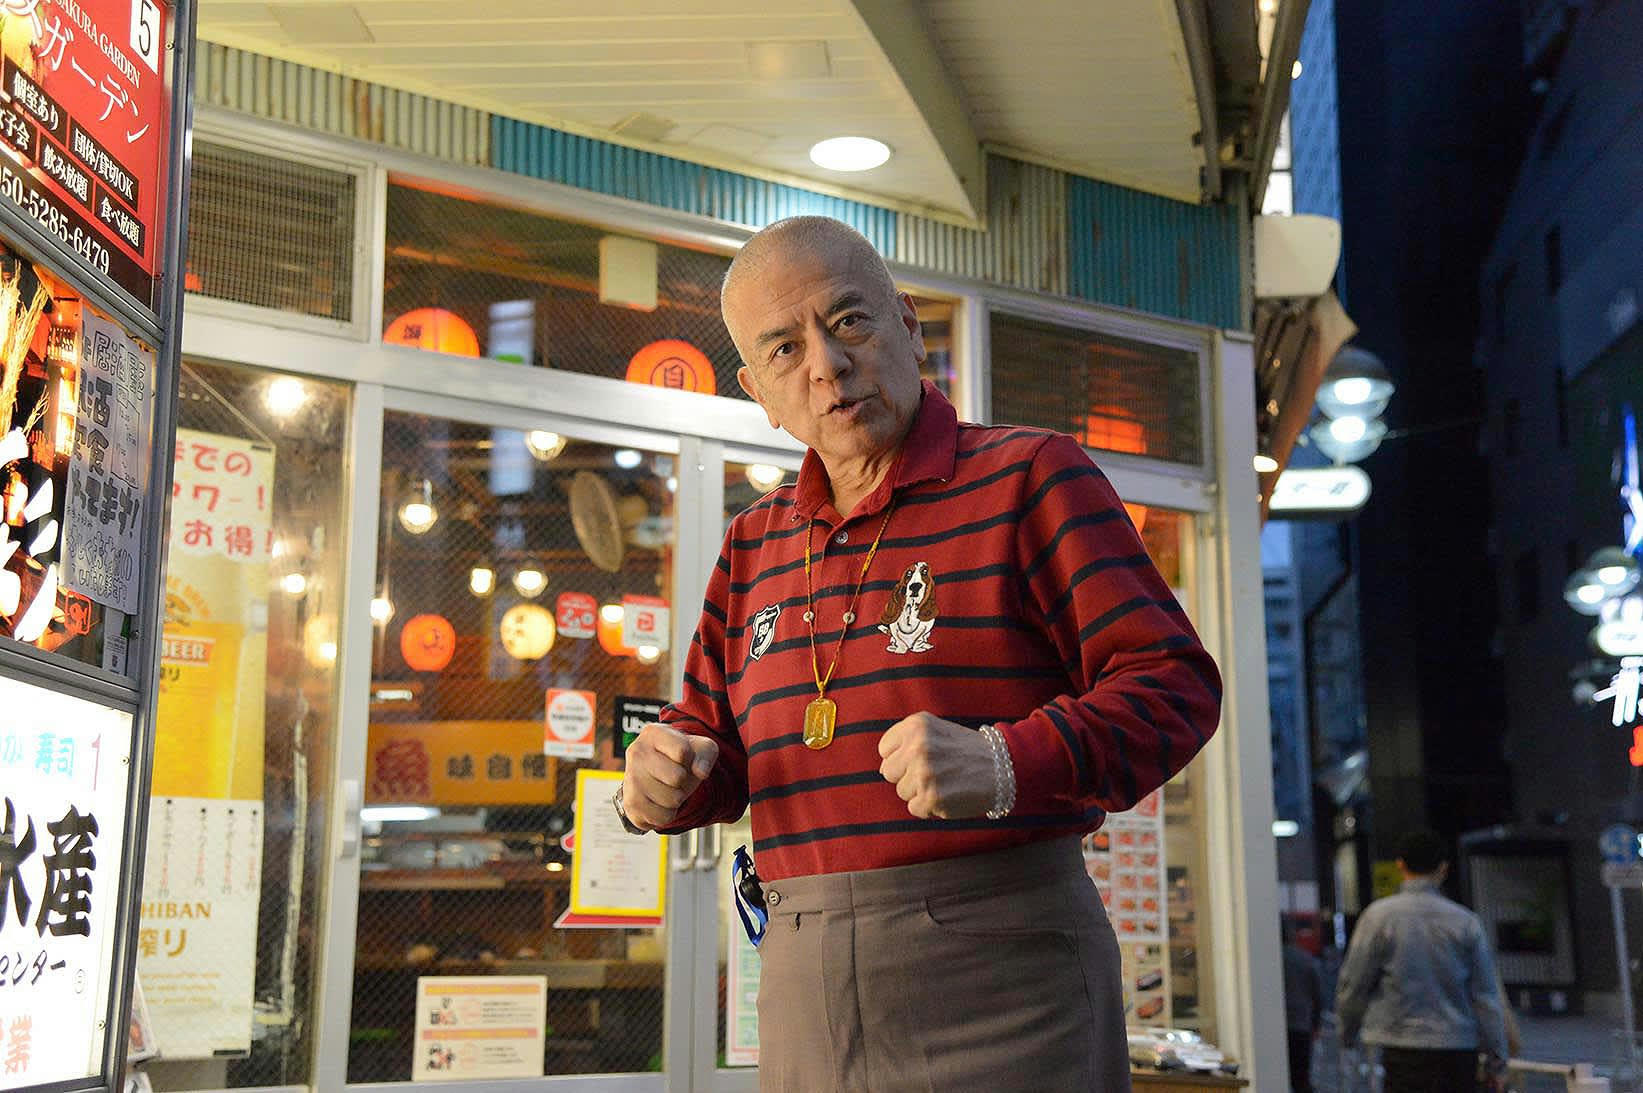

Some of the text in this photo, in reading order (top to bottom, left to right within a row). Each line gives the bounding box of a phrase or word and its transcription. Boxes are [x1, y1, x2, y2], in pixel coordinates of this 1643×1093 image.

[138, 0, 153, 57] 5
[99, 33, 141, 88] GARDEN
[43, 143, 89, 202] 飲み放題
[100, 196, 140, 248] 食べ放題
